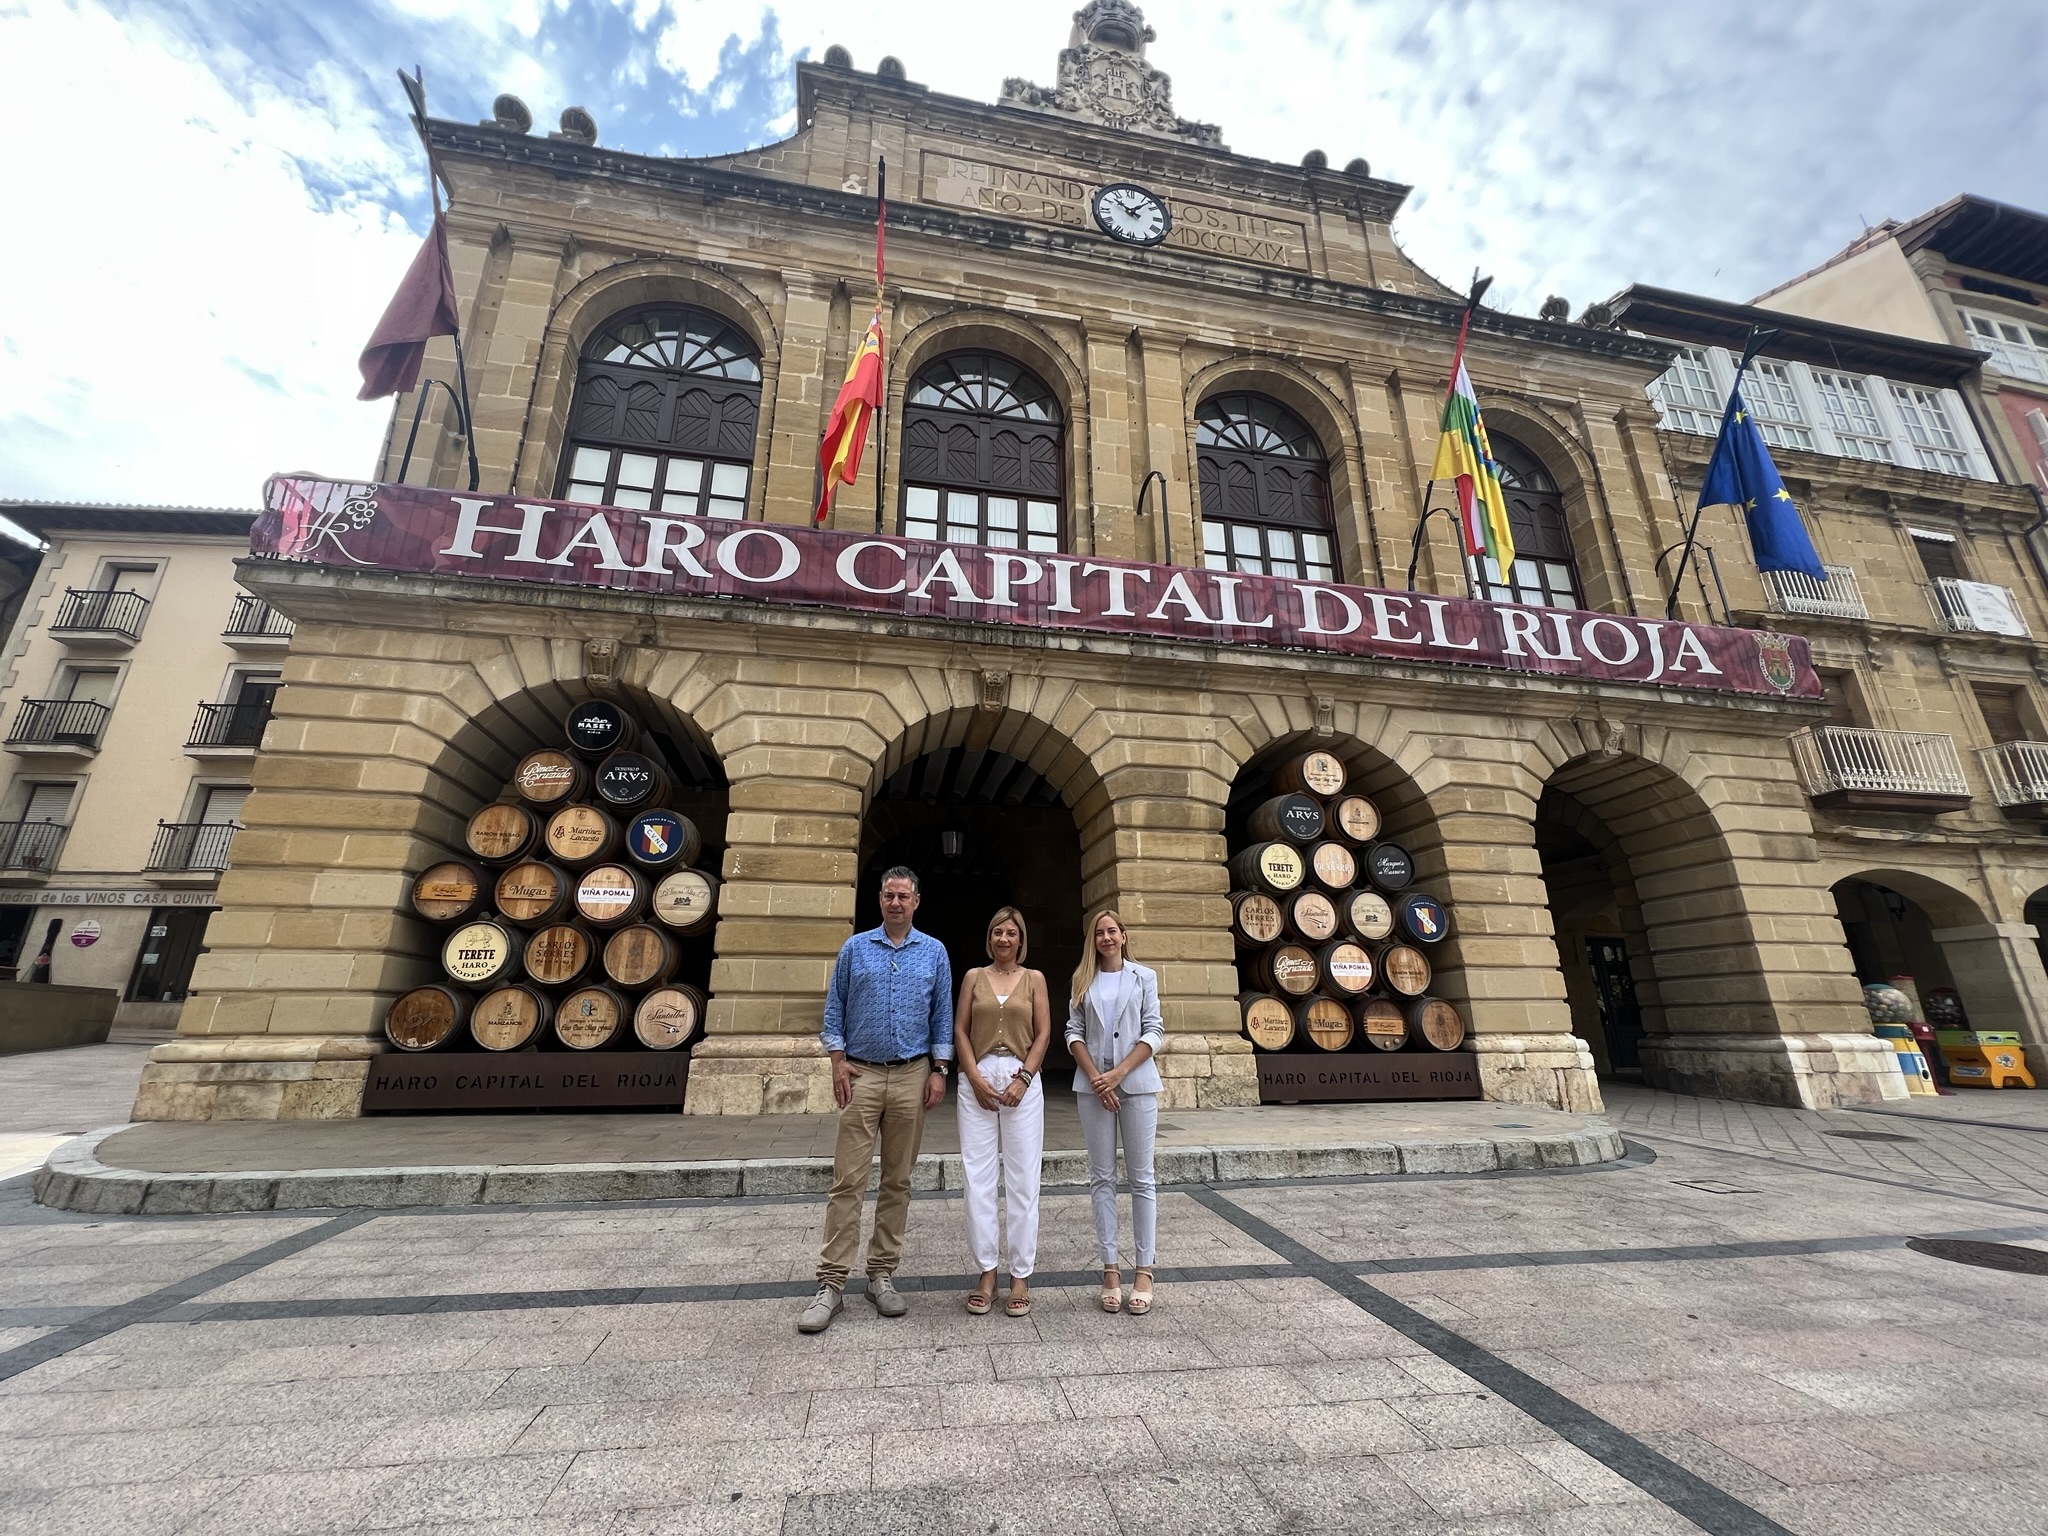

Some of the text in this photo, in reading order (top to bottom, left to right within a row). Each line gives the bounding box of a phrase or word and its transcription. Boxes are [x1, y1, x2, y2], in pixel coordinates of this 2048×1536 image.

[952, 161, 1096, 201] REINAND
[439, 496, 1723, 682] HARO CAPITAL DEL RIOJA
[577, 722, 613, 730] MASET
[568, 826, 602, 836] Martínez
[1268, 862, 1293, 872] TERETE
[509, 885, 547, 897] Muga
[581, 888, 631, 897] VIÑA POMAL
[41, 892, 56, 903] de
[60, 892, 80, 904] los
[85, 893, 125, 904] VINOS
[133, 893, 168, 905] CASA
[172, 893, 217, 905] QUINTI
[1245, 906, 1275, 914] CARLOS
[1245, 914, 1275, 922] SERRES
[538, 940, 577, 950] CARLOS
[458, 949, 496, 960] TERETE
[536, 949, 576, 958] SERRES
[451, 964, 497, 979] BODEGAS
[1332, 963, 1370, 971] VIÑA POMAL
[647, 1008, 685, 1020] Santalba
[1314, 1018, 1343, 1029] Muga
[375, 1073, 678, 1090] HARO CAPITAL DEL RIOJA
[1264, 1070, 1473, 1085] HARO CAPITAL DEL RIOJA
